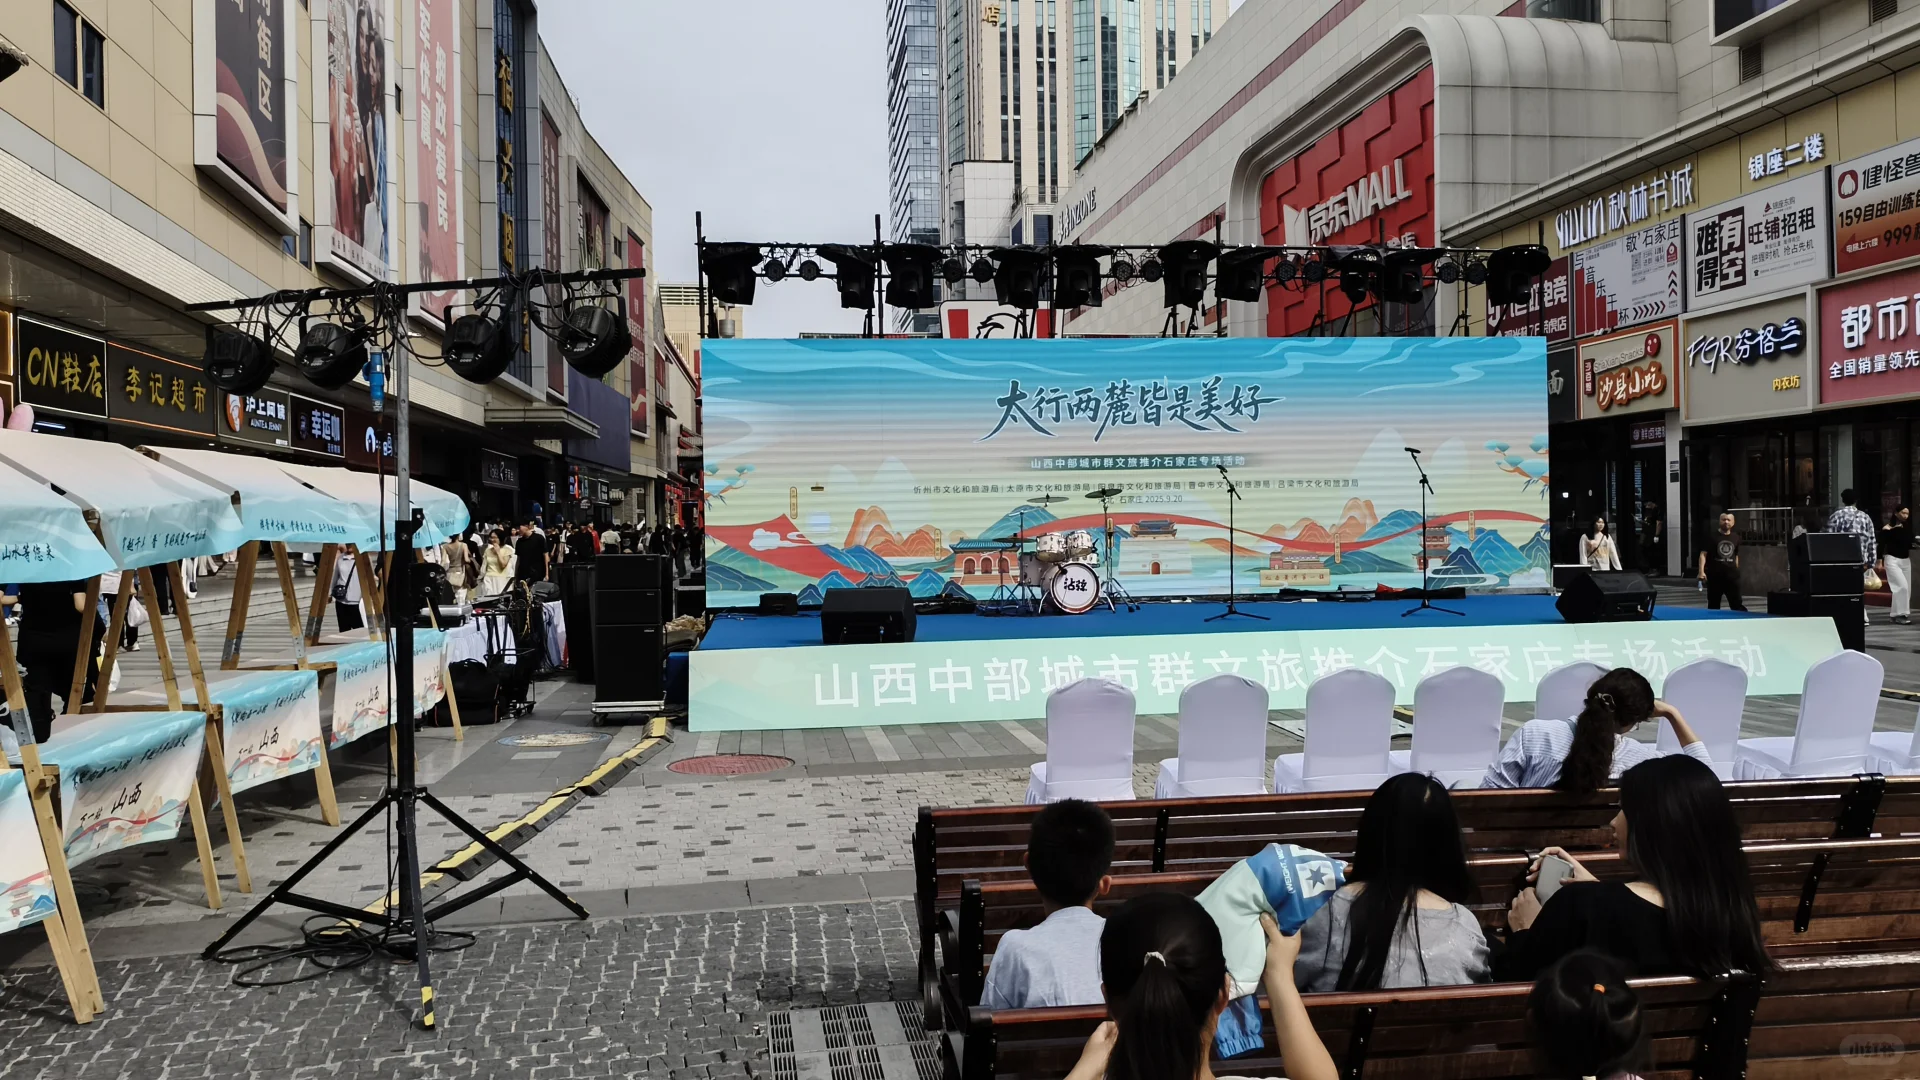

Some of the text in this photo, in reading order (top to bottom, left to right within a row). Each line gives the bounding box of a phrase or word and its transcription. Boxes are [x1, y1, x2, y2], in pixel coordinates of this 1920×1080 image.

[257, 0, 272, 122] 街区
[1748, 132, 1825, 182] 银座二楼
[1309, 158, 1413, 245] 京东MALL
[1608, 162, 1695, 232] 秋林书城
[1747, 206, 1816, 245] 旺铺招租
[1751, 249, 1780, 265] 把握时机
[1783, 239, 1814, 256] 抢占先机
[1841, 290, 1920, 350] 都市
[28, 346, 103, 399] CN鞋店
[1620, 346, 1644, 363] Snacks
[1829, 349, 1920, 380] 全国销量领先
[126, 366, 207, 414] 李记超市
[1599, 365, 1662, 406] 沙县小吃
[1772, 375, 1801, 391] 内衣坊
[973, 374, 1287, 443] 太行两麓皆是美好
[1031, 455, 1245, 469] 山西中部城市群文旅推介石家庄专场活动
[1006, 482, 1091, 493] 太原市文化和旅游局
[1145, 494, 1183, 504] 2025.9.20
[111, 781, 142, 814] 山西
